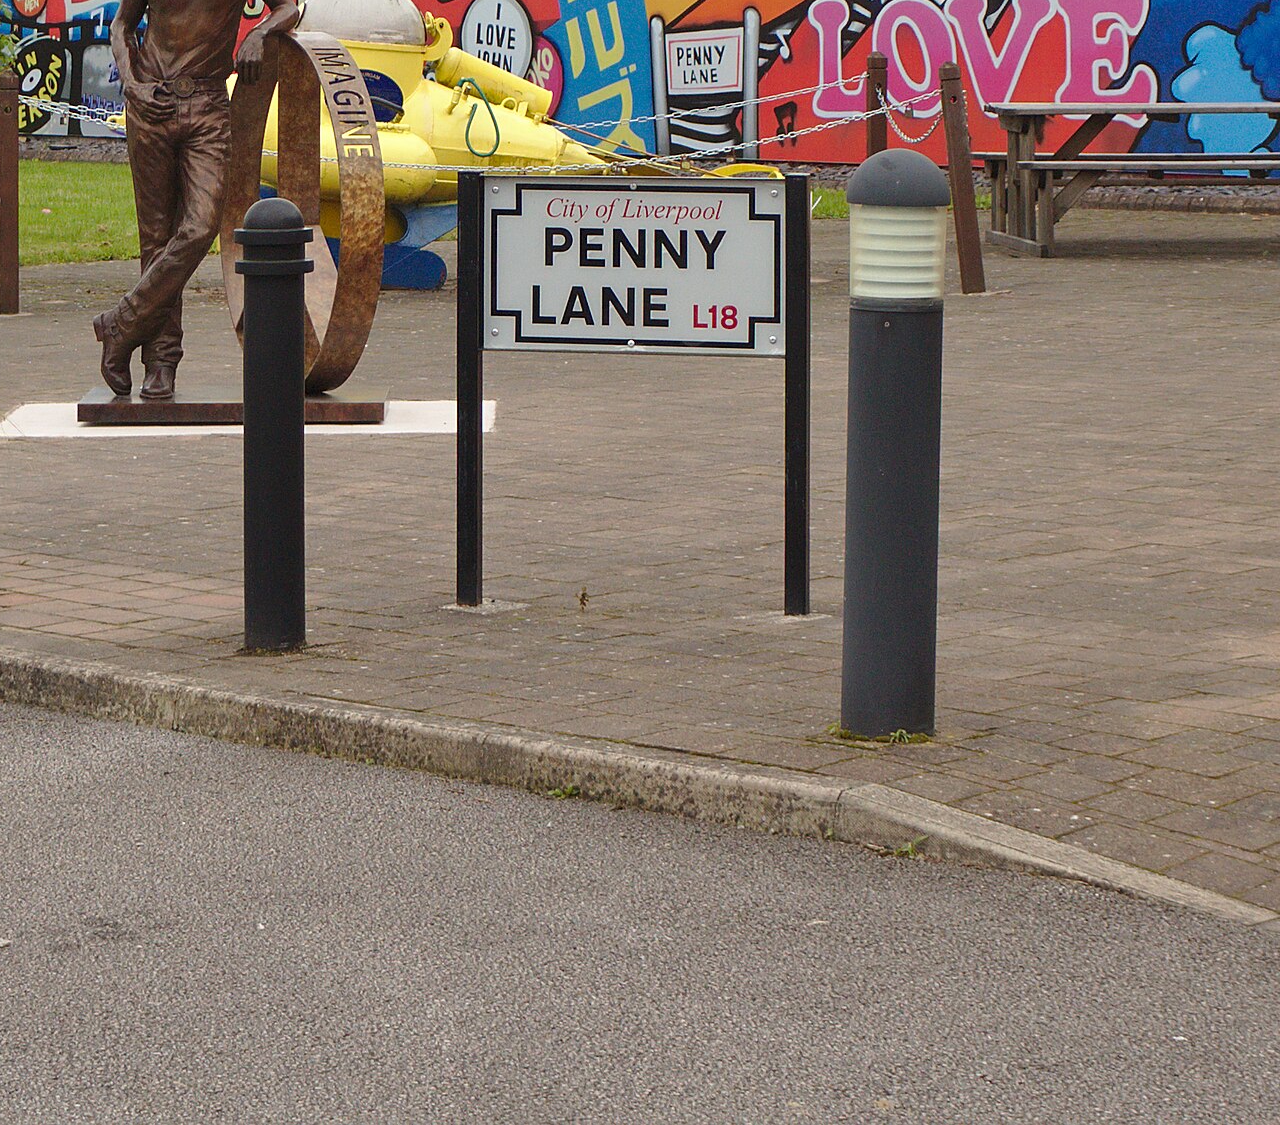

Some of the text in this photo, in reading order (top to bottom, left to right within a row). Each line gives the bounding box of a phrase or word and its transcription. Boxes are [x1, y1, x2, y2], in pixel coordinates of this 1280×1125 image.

[496, 3, 502, 21] I
[476, 22, 516, 50] LOVE
[676, 45, 726, 67] PENNY
[683, 68, 718, 85] LANE
[18, 53, 62, 129] ERSON
[311, 47, 375, 158] IMAGINE
[546, 197, 723, 225] City of Liverpool
[544, 226, 727, 270] PENNY
[531, 284, 738, 330] LANE L18
